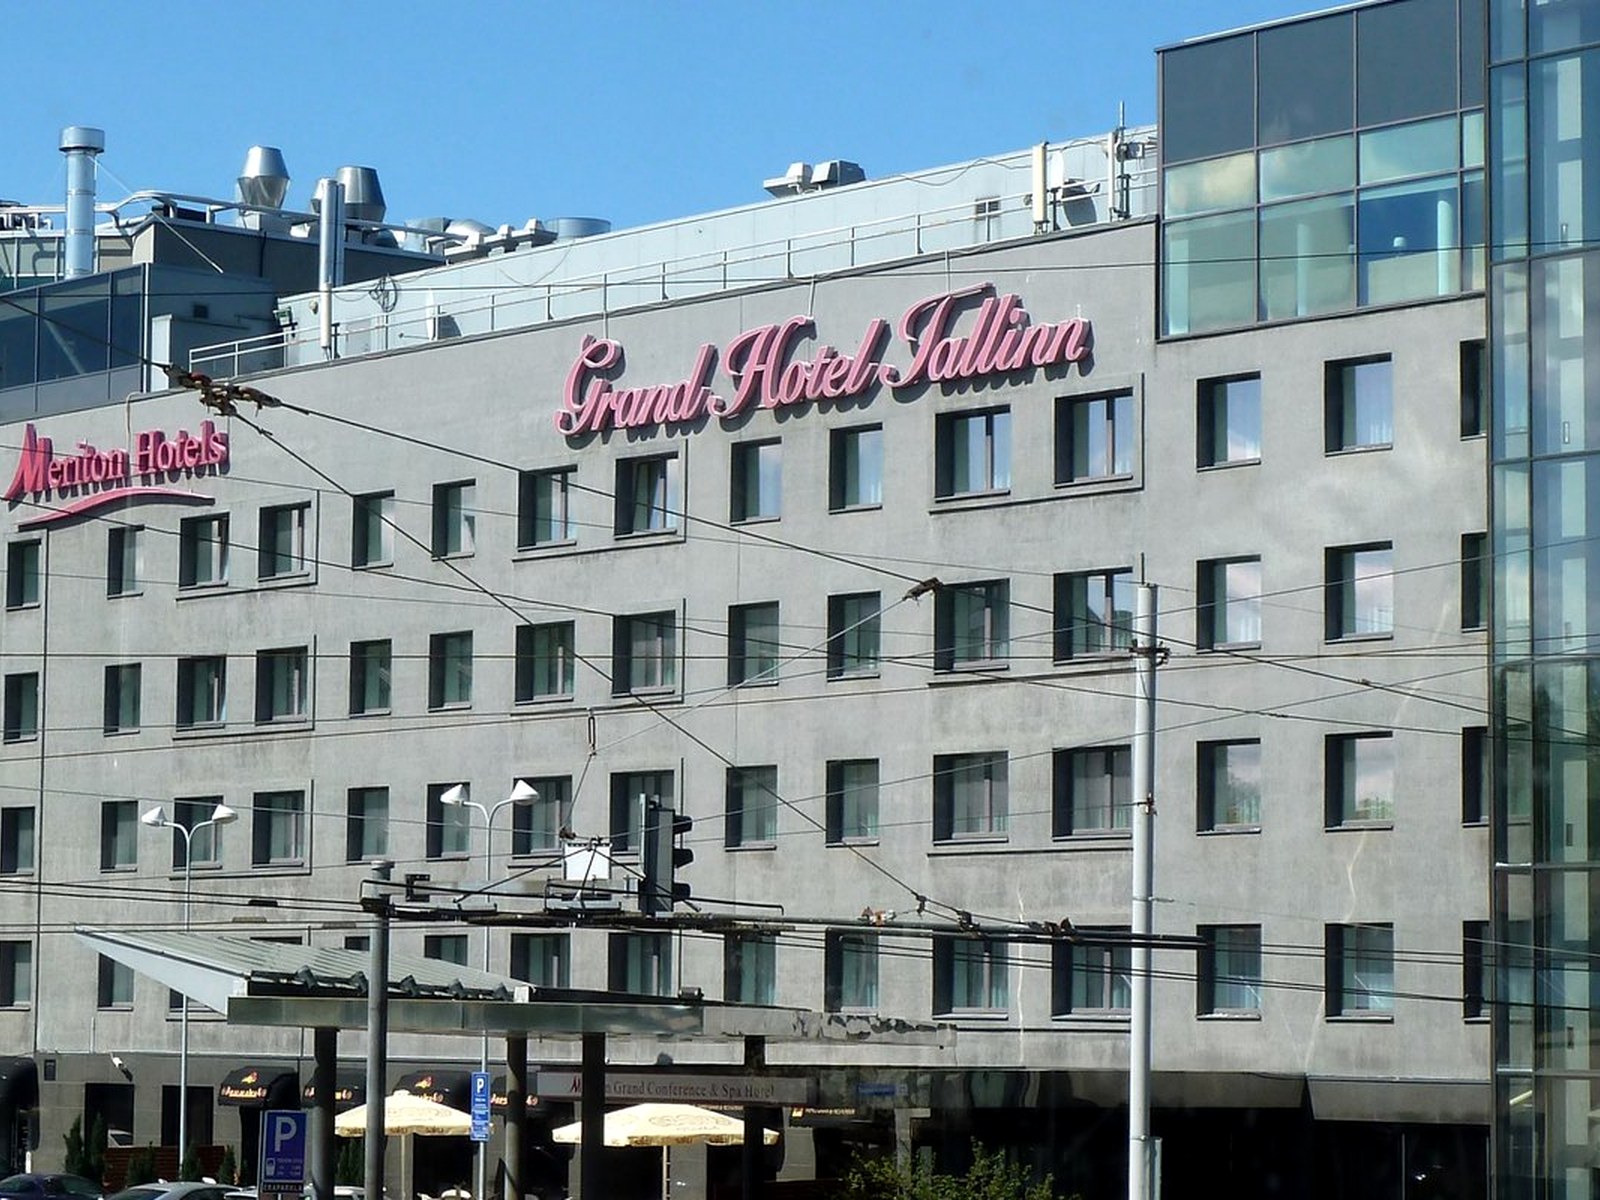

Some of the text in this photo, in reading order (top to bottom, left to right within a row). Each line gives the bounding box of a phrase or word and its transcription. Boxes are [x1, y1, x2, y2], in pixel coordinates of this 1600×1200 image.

[554, 281, 1088, 435] Grand Hotel Tallinn
[4, 420, 229, 501] Meriton Hotels
[475, 1077, 486, 1095] P
[613, 1080, 645, 1096] Grand
[647, 1081, 706, 1098] Conference
[709, 1083, 718, 1097] &
[721, 1083, 742, 1099] Spa
[745, 1085, 775, 1099] Hotel
[274, 1116, 297, 1153] P
